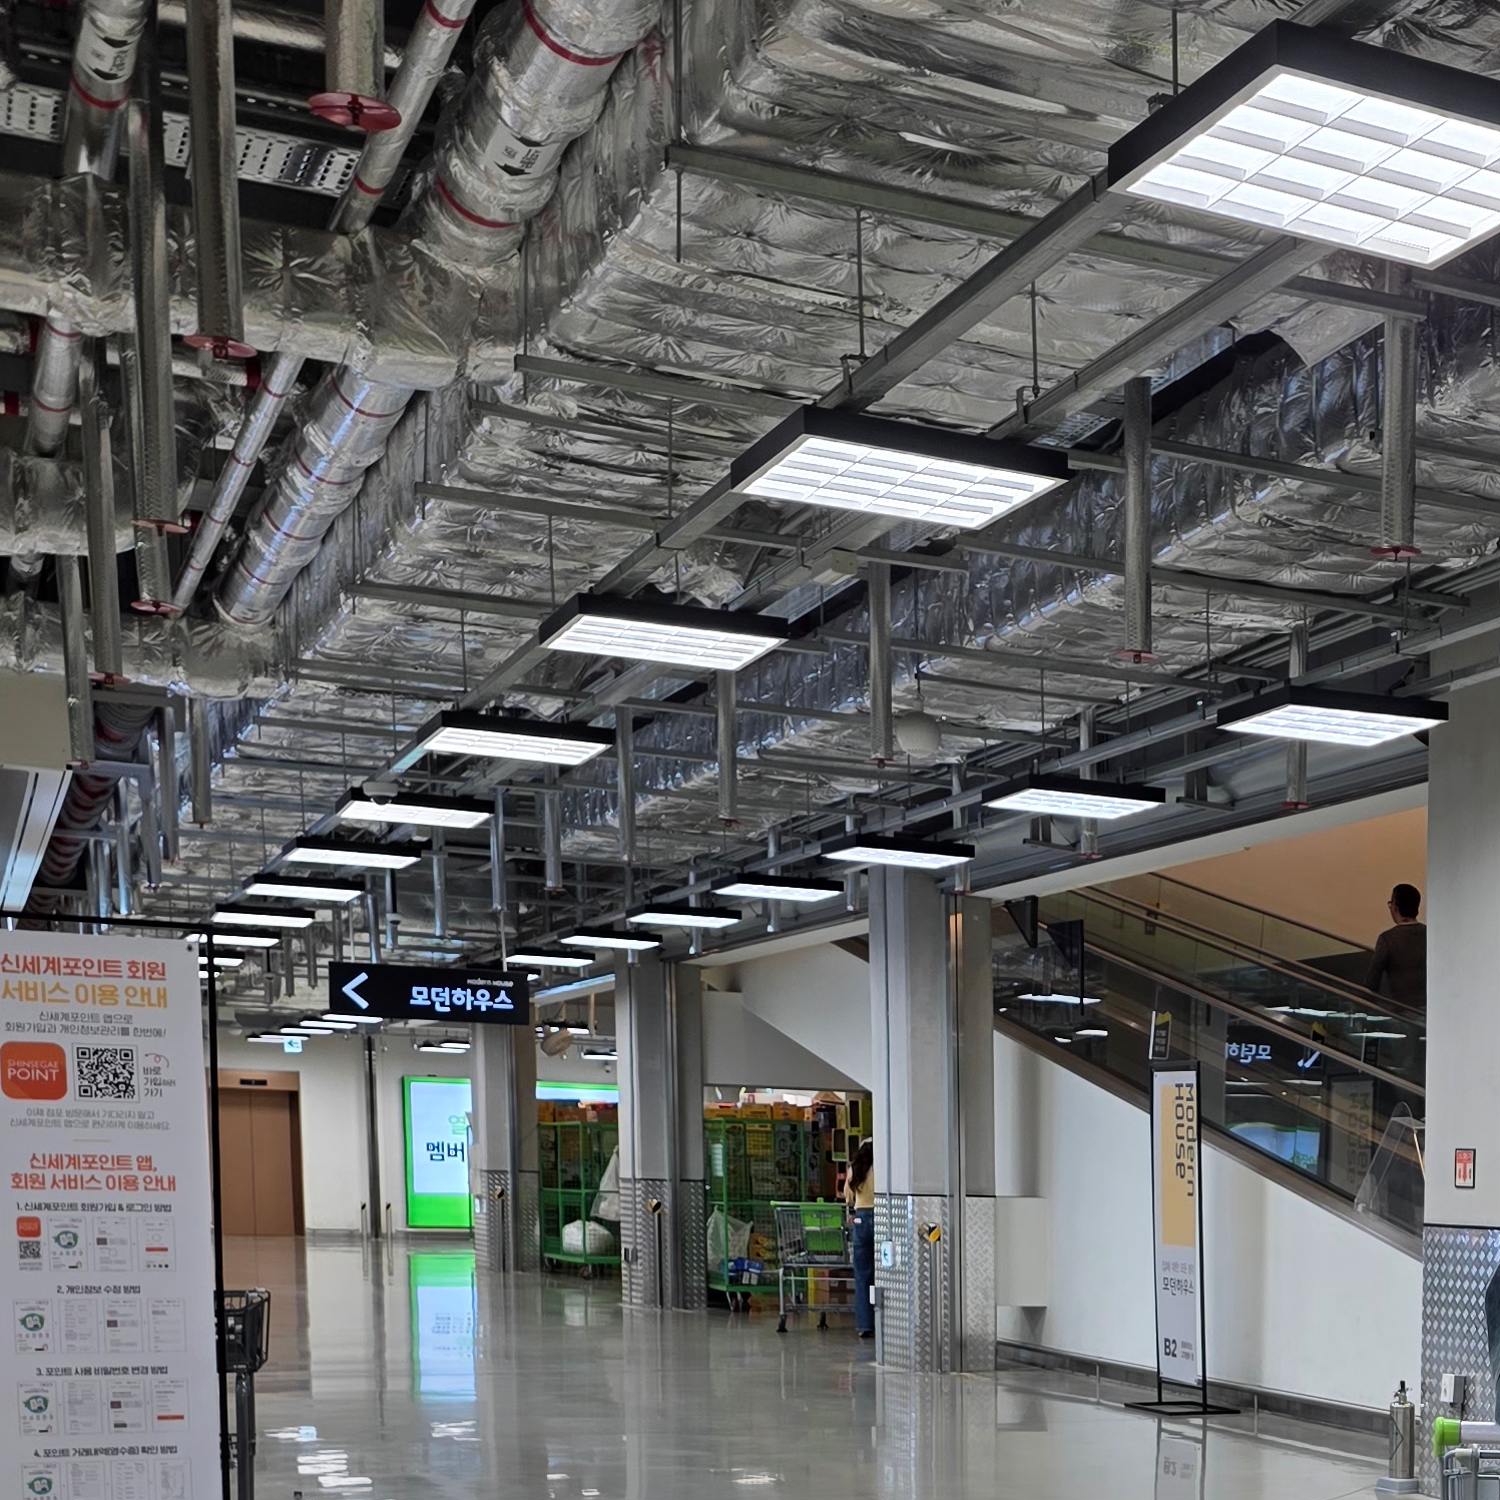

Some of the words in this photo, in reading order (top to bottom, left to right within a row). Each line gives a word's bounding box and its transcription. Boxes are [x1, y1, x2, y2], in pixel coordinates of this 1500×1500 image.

[0, 953, 123, 978] 신세계포인트
[127, 960, 167, 981] 회원
[2, 980, 70, 1003] 서비스
[74, 983, 119, 1006] 이용
[124, 985, 168, 1009] 안내
[409, 986, 515, 1012] 모던하우스
[7, 1068, 59, 1081] POINT
[1185, 1083, 1198, 1197] Modern
[426, 1141, 465, 1162] 멤버
[29, 1153, 133, 1171] 신세계포인트
[136, 1155, 157, 1173] 앱,
[11, 1172, 46, 1190] 회원
[50, 1173, 102, 1191] 서비스
[105, 1174, 140, 1192] 이용
[143, 1175, 176, 1192] 안내
[1164, 1338, 1177, 1358] B2
